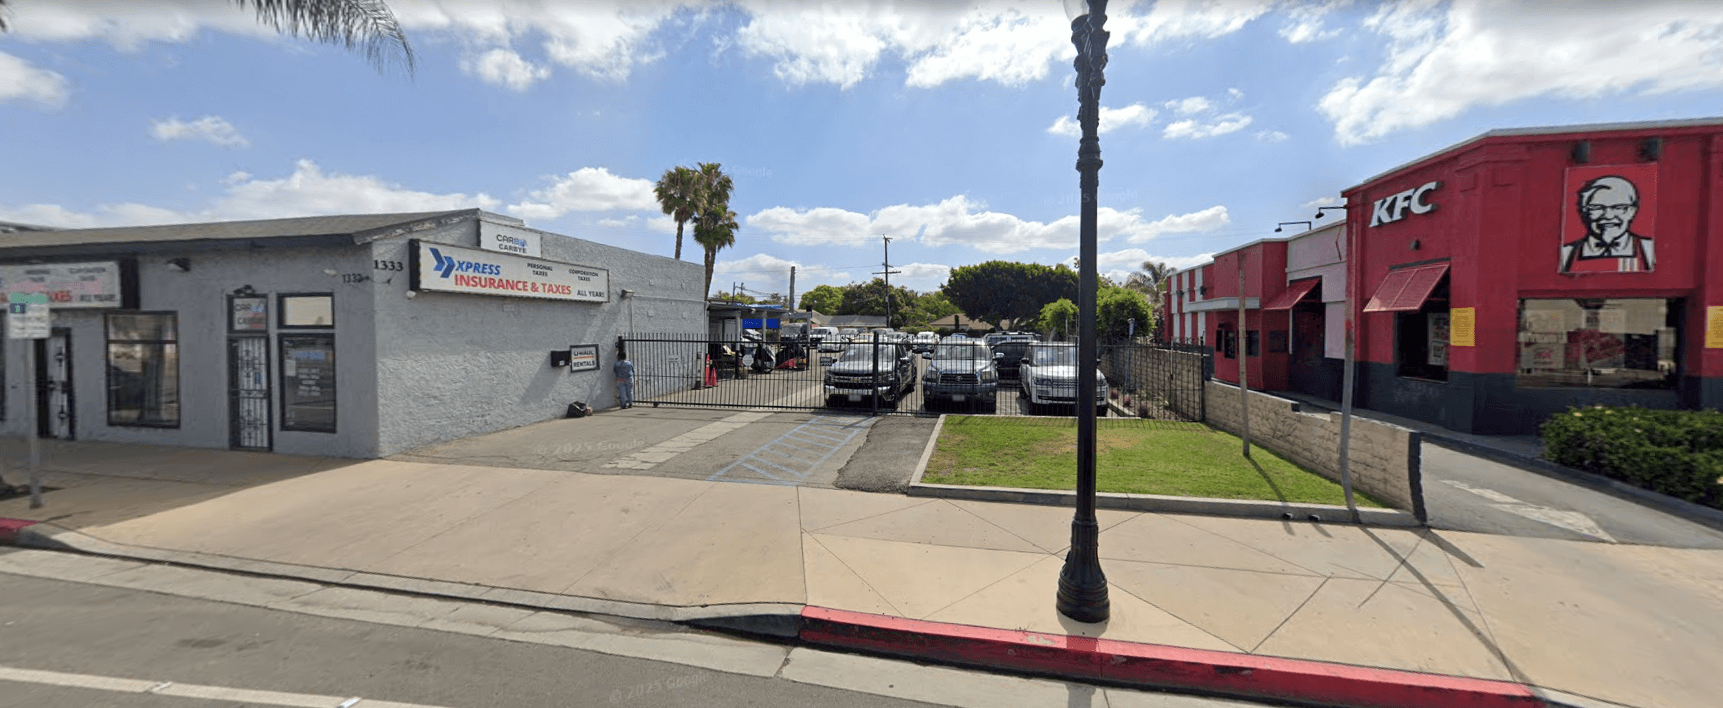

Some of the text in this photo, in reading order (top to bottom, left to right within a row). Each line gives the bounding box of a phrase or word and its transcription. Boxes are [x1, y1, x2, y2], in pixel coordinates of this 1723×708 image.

[1369, 181, 1439, 228] KFC
[498, 243, 527, 254] CARBYE
[373, 259, 404, 272] 1333
[456, 260, 501, 276] XPRESS
[527, 262, 553, 272] PERSONAL
[568, 268, 599, 277] CORPORATION
[454, 273, 571, 295] INSURANCE & TAXES
[577, 289, 604, 298] ALL YEAR!
[573, 360, 595, 368] RENTALS
